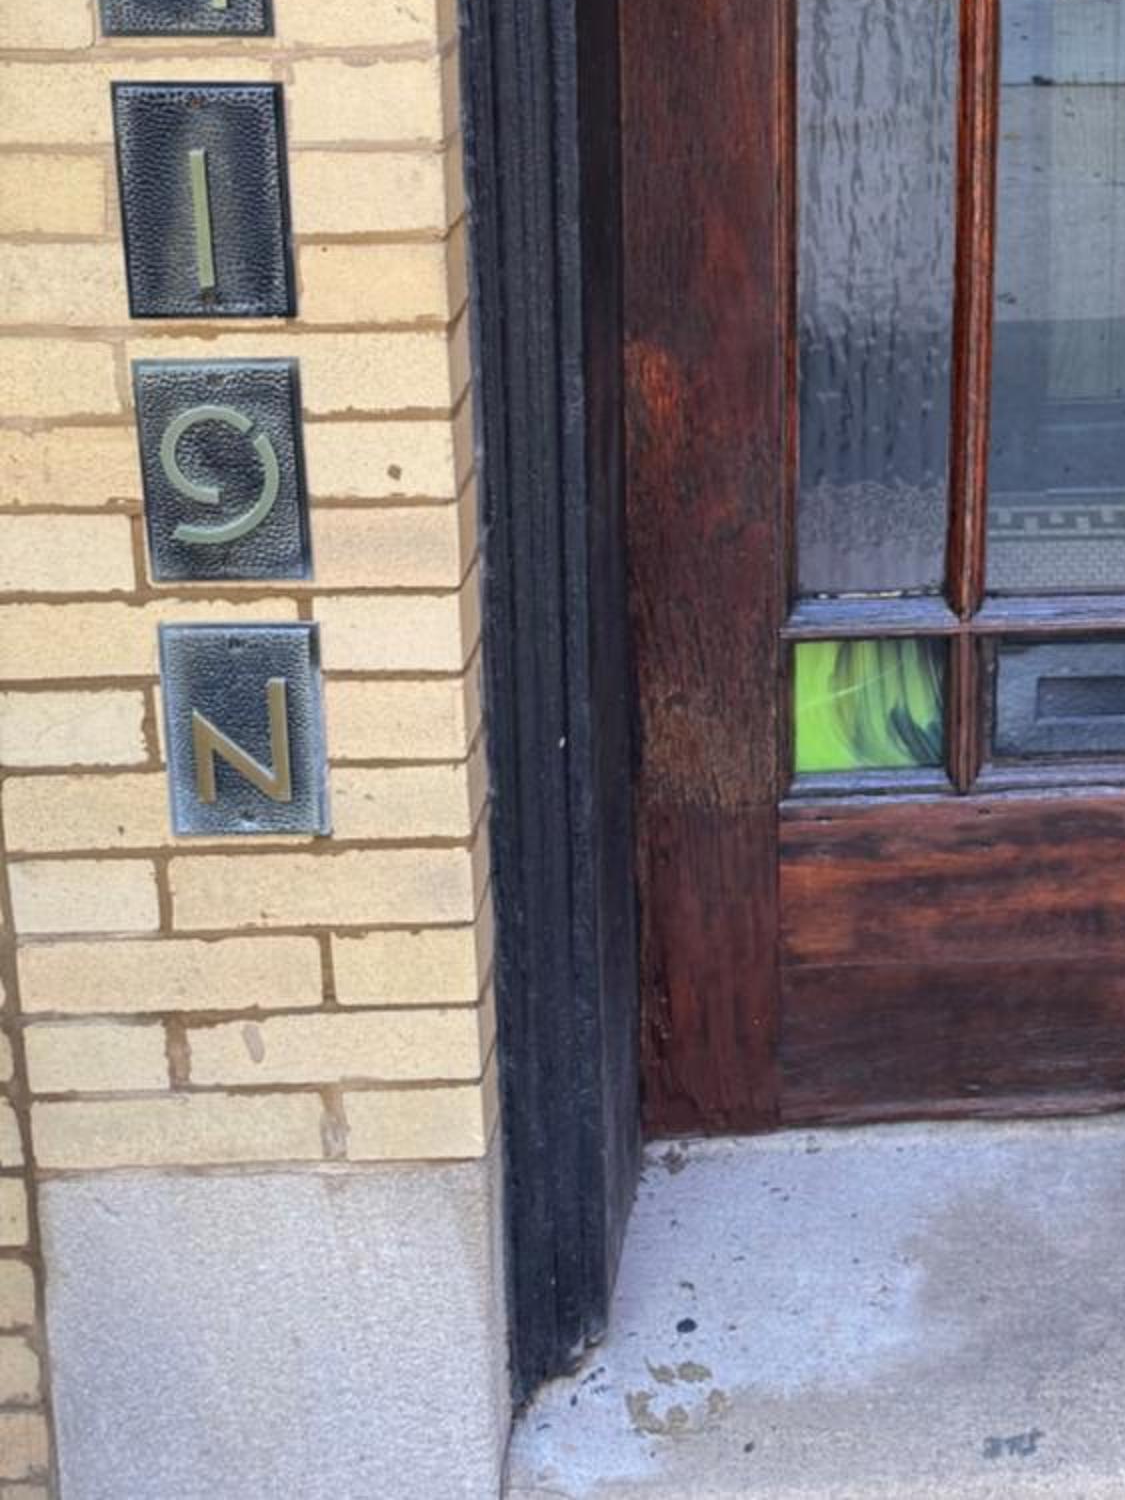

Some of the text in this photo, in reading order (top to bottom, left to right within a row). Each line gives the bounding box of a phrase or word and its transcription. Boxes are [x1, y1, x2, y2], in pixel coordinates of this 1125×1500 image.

[188, 148, 215, 288] 1
[159, 404, 280, 543] 9
[191, 677, 292, 801] N
